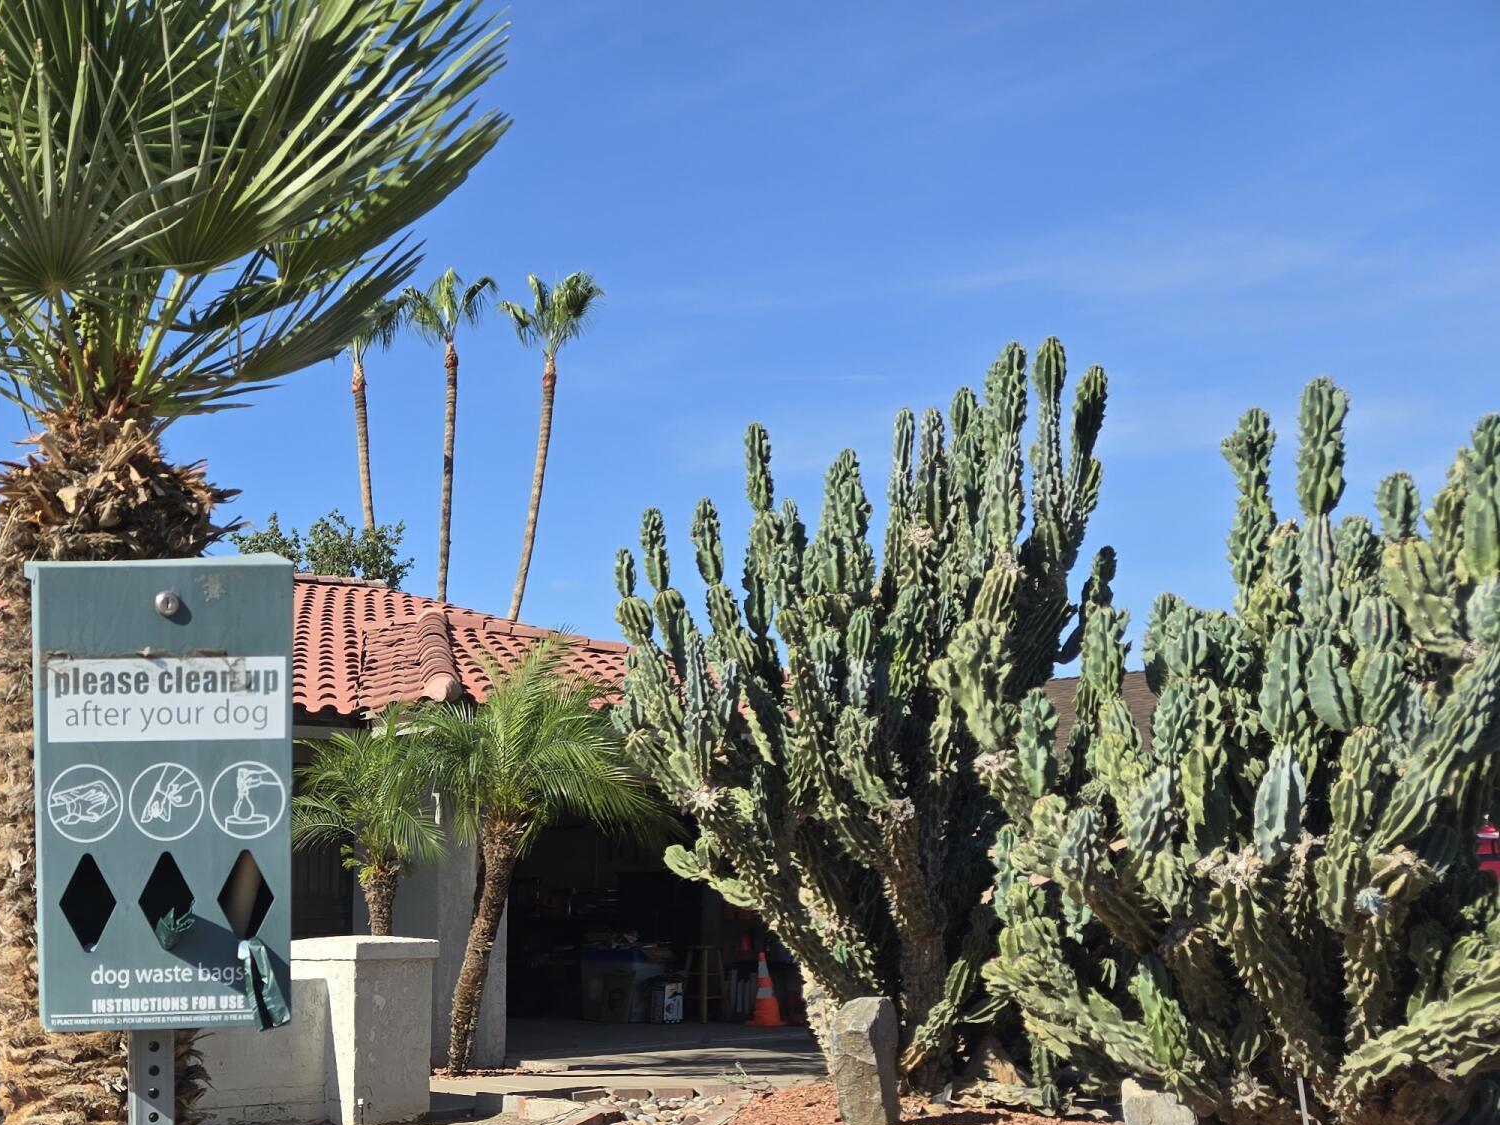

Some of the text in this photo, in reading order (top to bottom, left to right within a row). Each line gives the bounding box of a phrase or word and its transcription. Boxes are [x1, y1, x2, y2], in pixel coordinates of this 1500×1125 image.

[54, 667, 149, 698] please
[245, 669, 278, 695] up
[65, 699, 268, 732] after your dog
[91, 962, 244, 988] dog waste bags
[92, 995, 245, 1013] INSTRUCTIONS FOR USE
